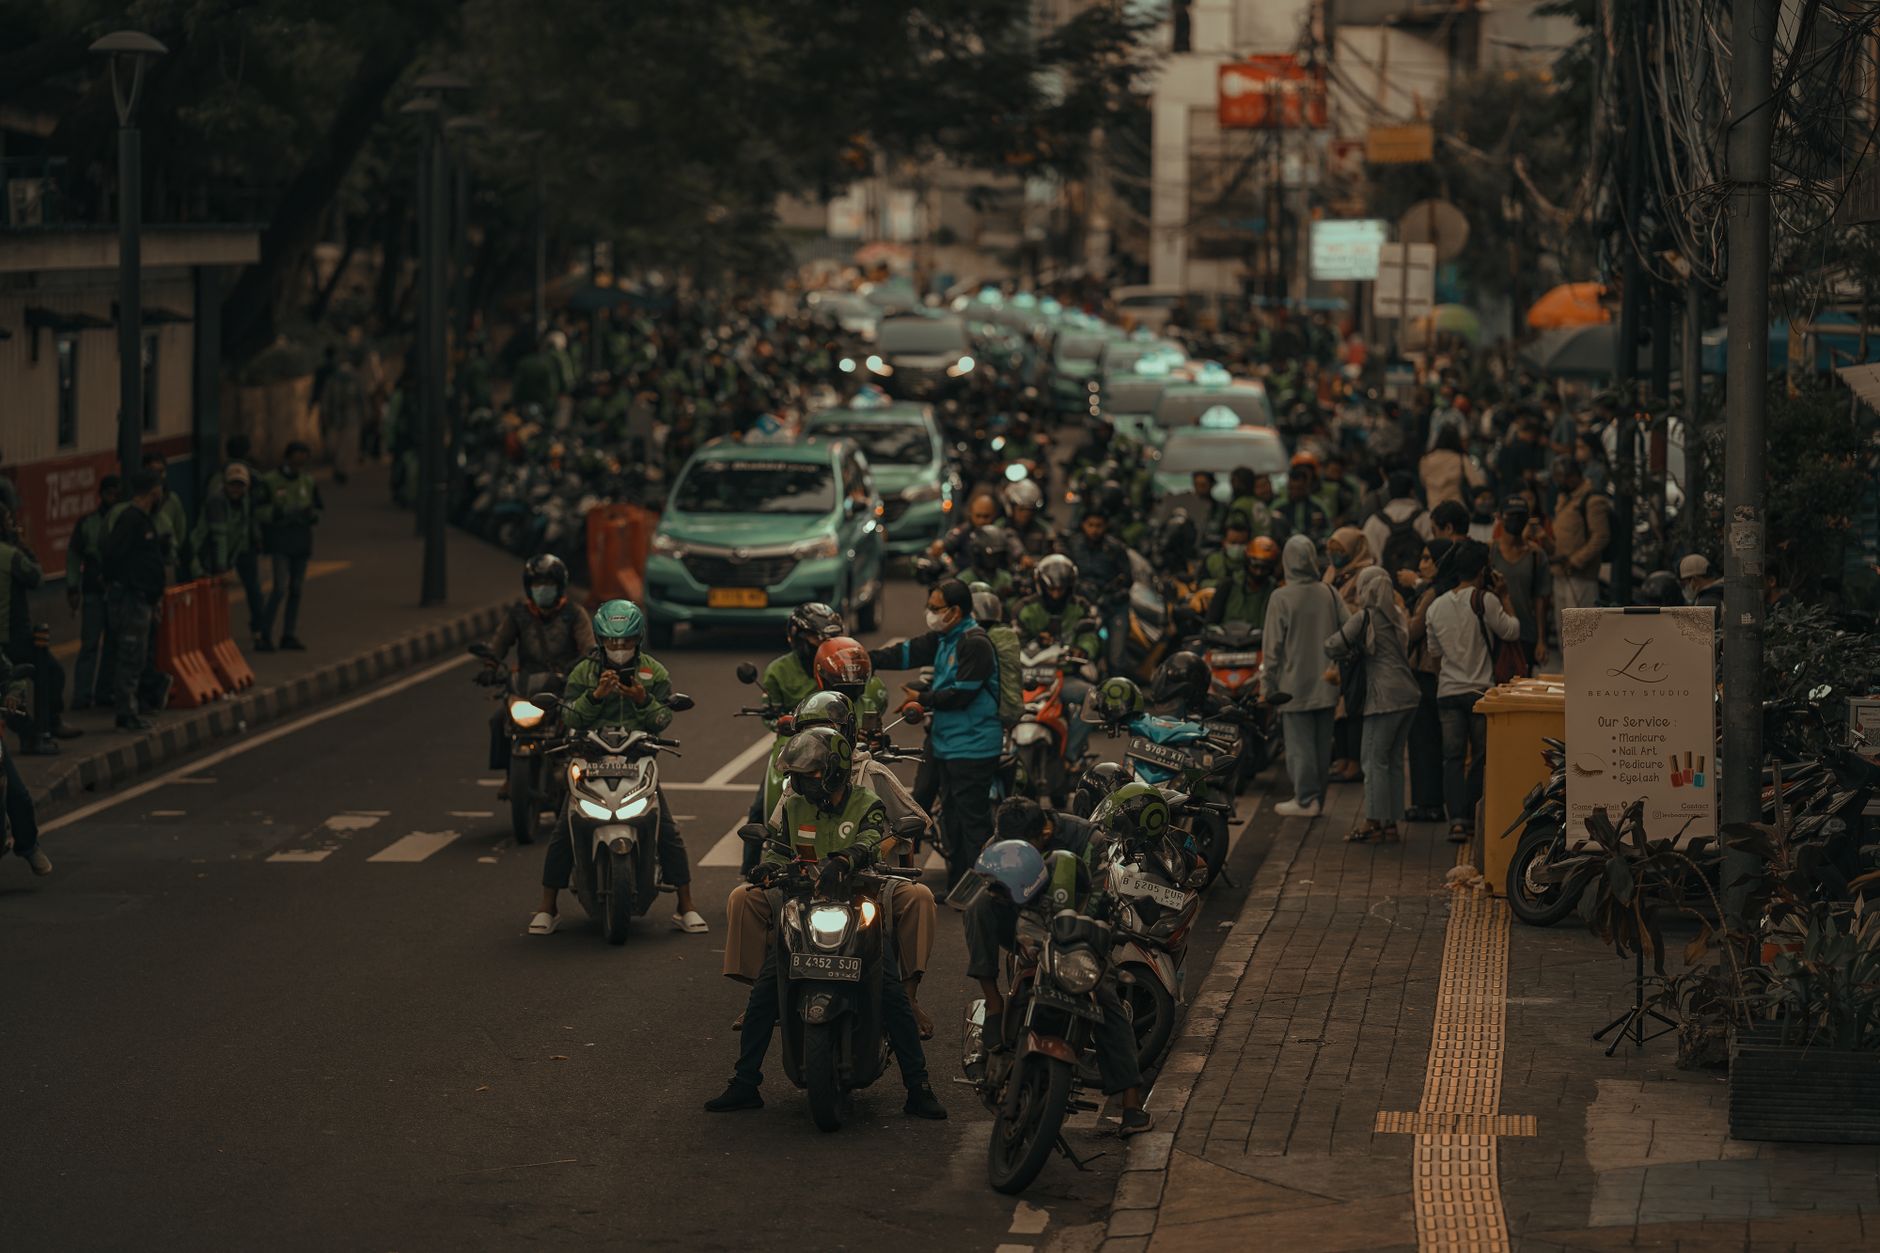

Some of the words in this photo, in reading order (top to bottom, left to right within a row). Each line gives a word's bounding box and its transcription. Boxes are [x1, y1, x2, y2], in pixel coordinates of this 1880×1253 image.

[1598, 716, 1619, 728] Our
[1623, 716, 1671, 728] Service
[1619, 733, 1666, 743] Manicure
[1619, 746, 1637, 756] Nail
[1640, 746, 1658, 756] Art
[1619, 759, 1664, 769] Pedicure
[1619, 772, 1660, 785] Eyelash
[1122, 877, 1129, 885] B
[793, 956, 800, 967] B
[805, 956, 832, 969] 4352
